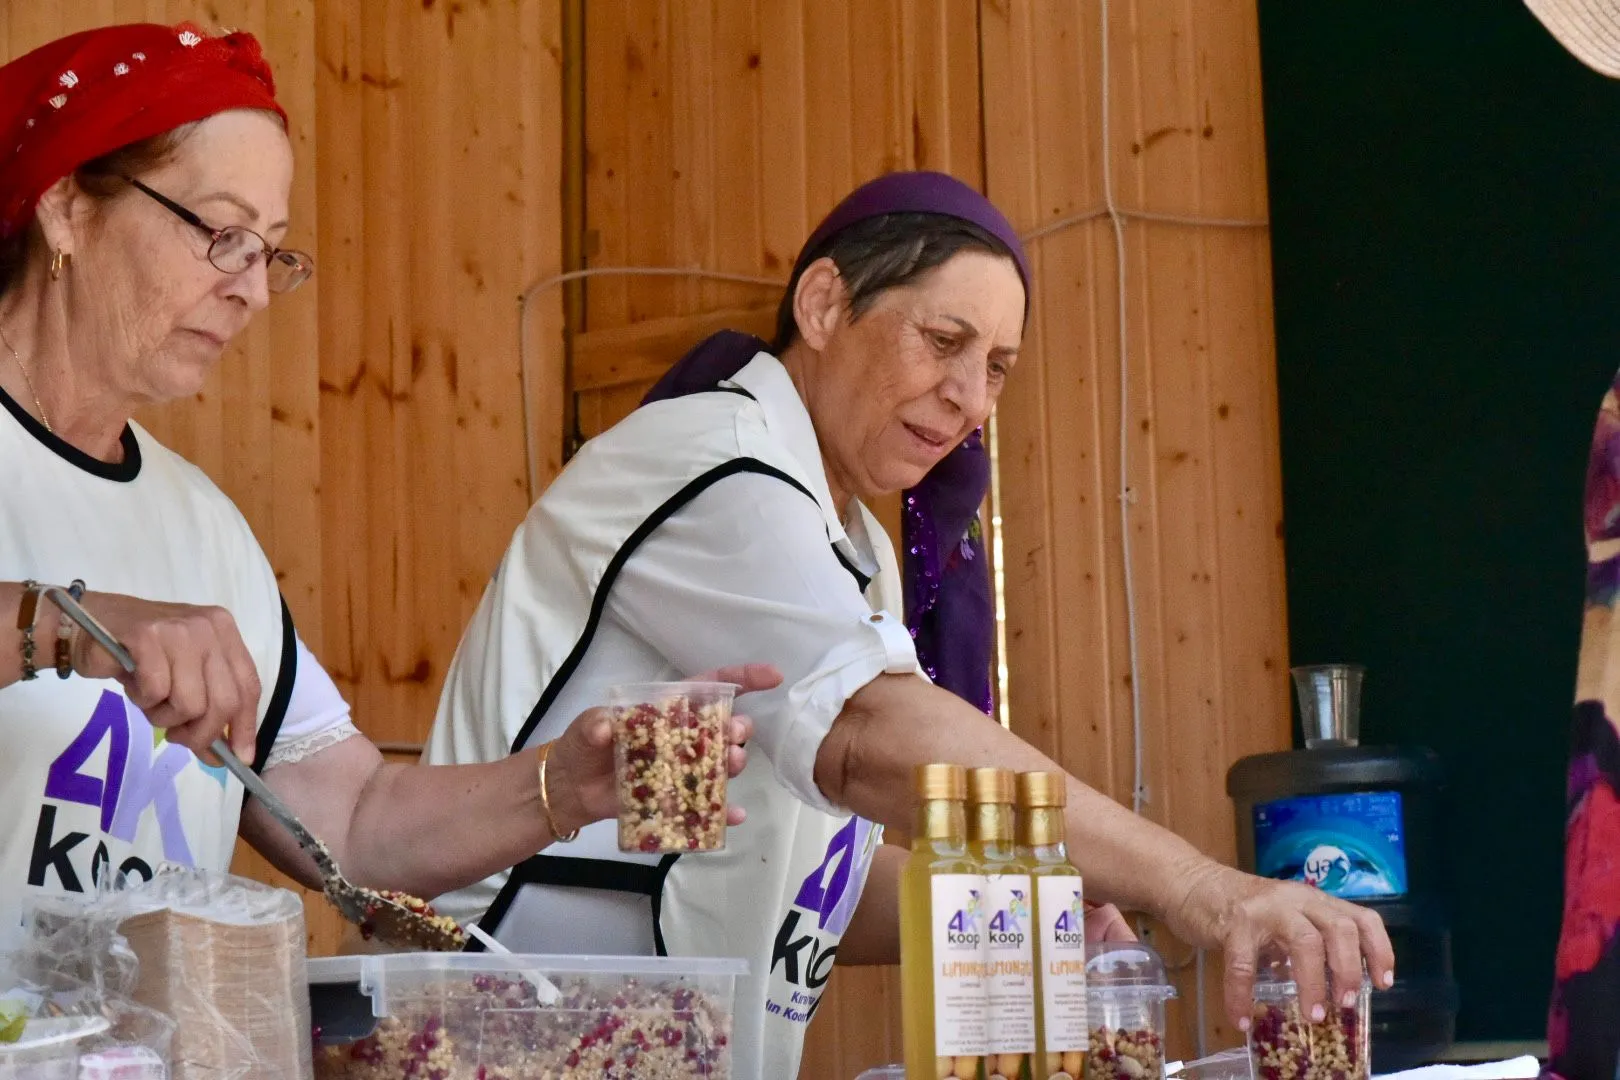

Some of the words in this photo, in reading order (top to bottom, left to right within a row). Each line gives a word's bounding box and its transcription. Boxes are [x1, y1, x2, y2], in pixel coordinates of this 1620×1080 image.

[988, 910, 1022, 932] 4K
[947, 931, 981, 950] koop
[988, 930, 1025, 949] koop
